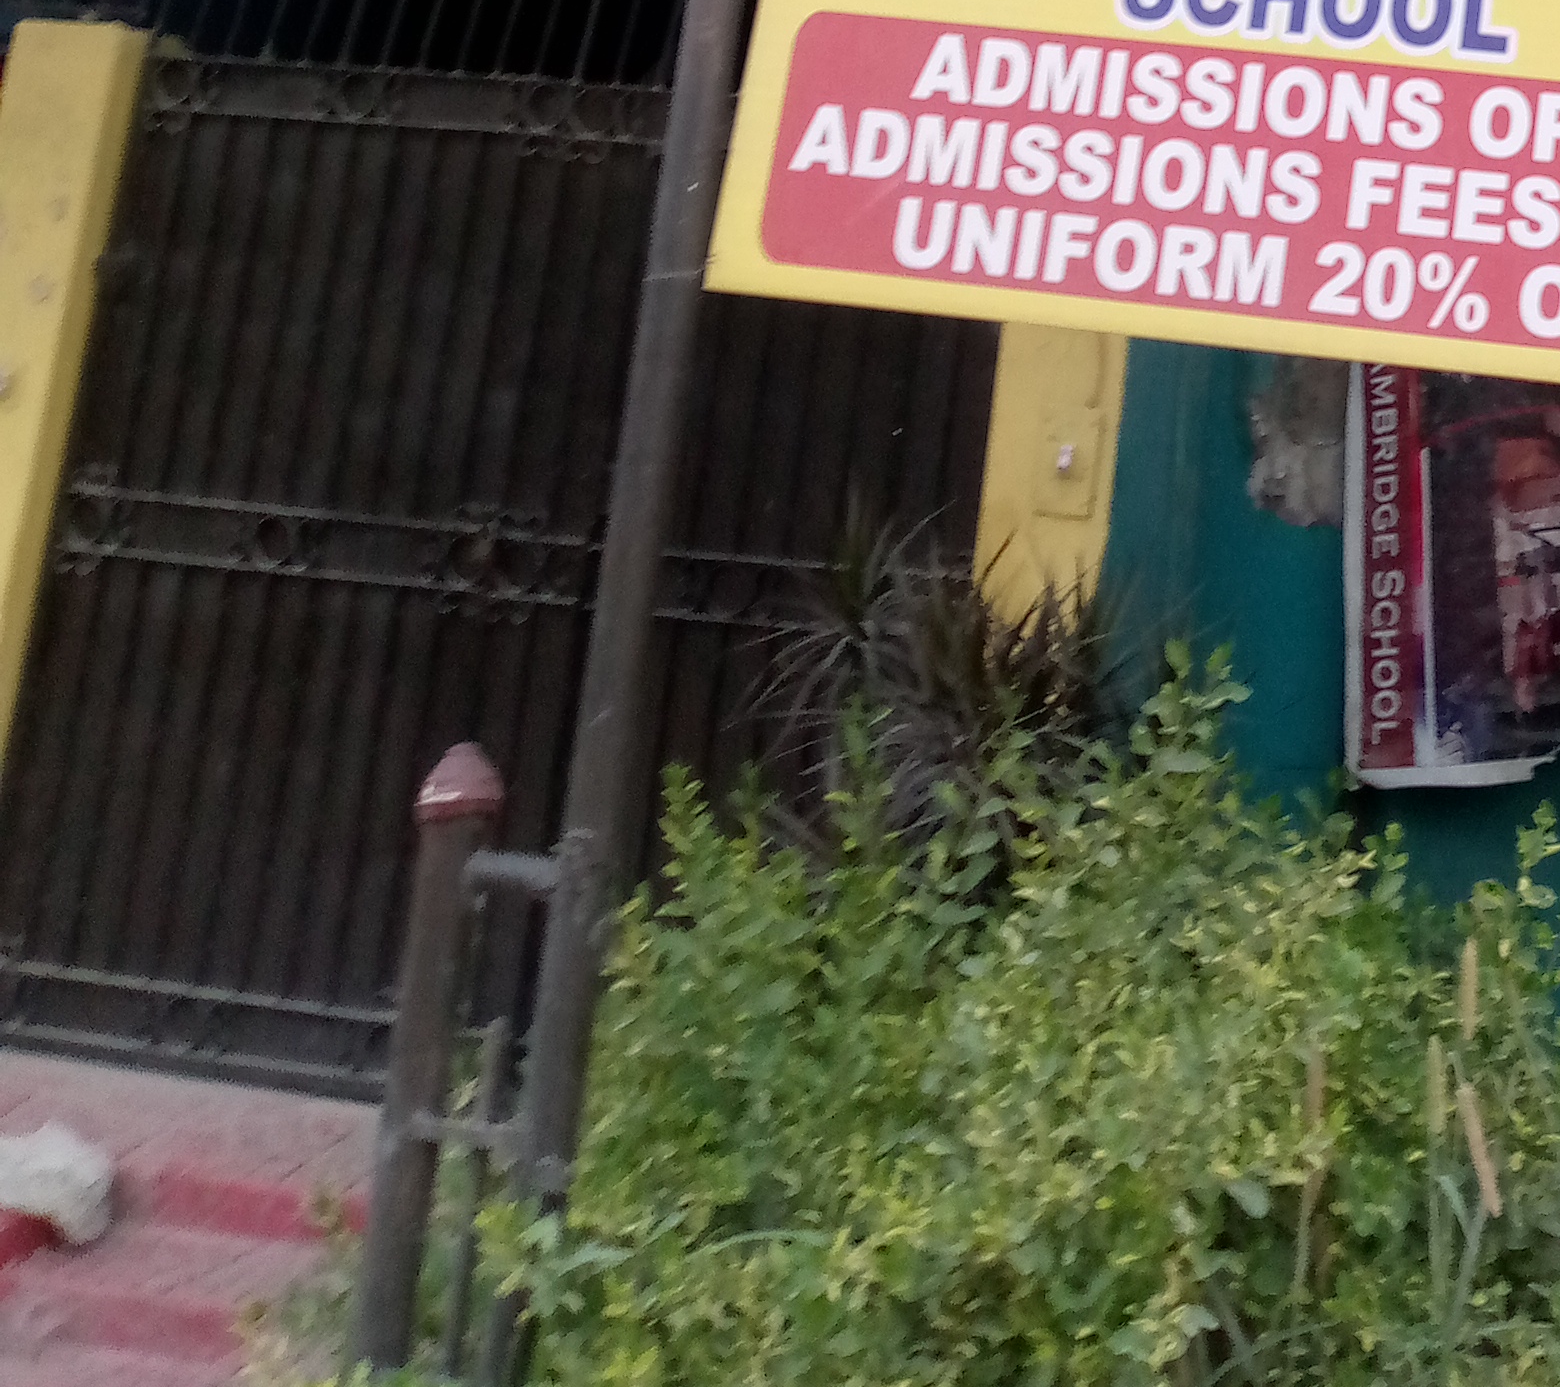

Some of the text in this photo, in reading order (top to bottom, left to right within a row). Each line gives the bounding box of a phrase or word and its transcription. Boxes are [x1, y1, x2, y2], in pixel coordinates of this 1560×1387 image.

[909, 31, 1445, 152] ADMISSIONS
[787, 102, 1323, 225] ADMISSIONS
[893, 196, 1290, 309] UNIFORM
[1307, 240, 1491, 334] 20%
[1369, 569, 1406, 746] SCHOOL
